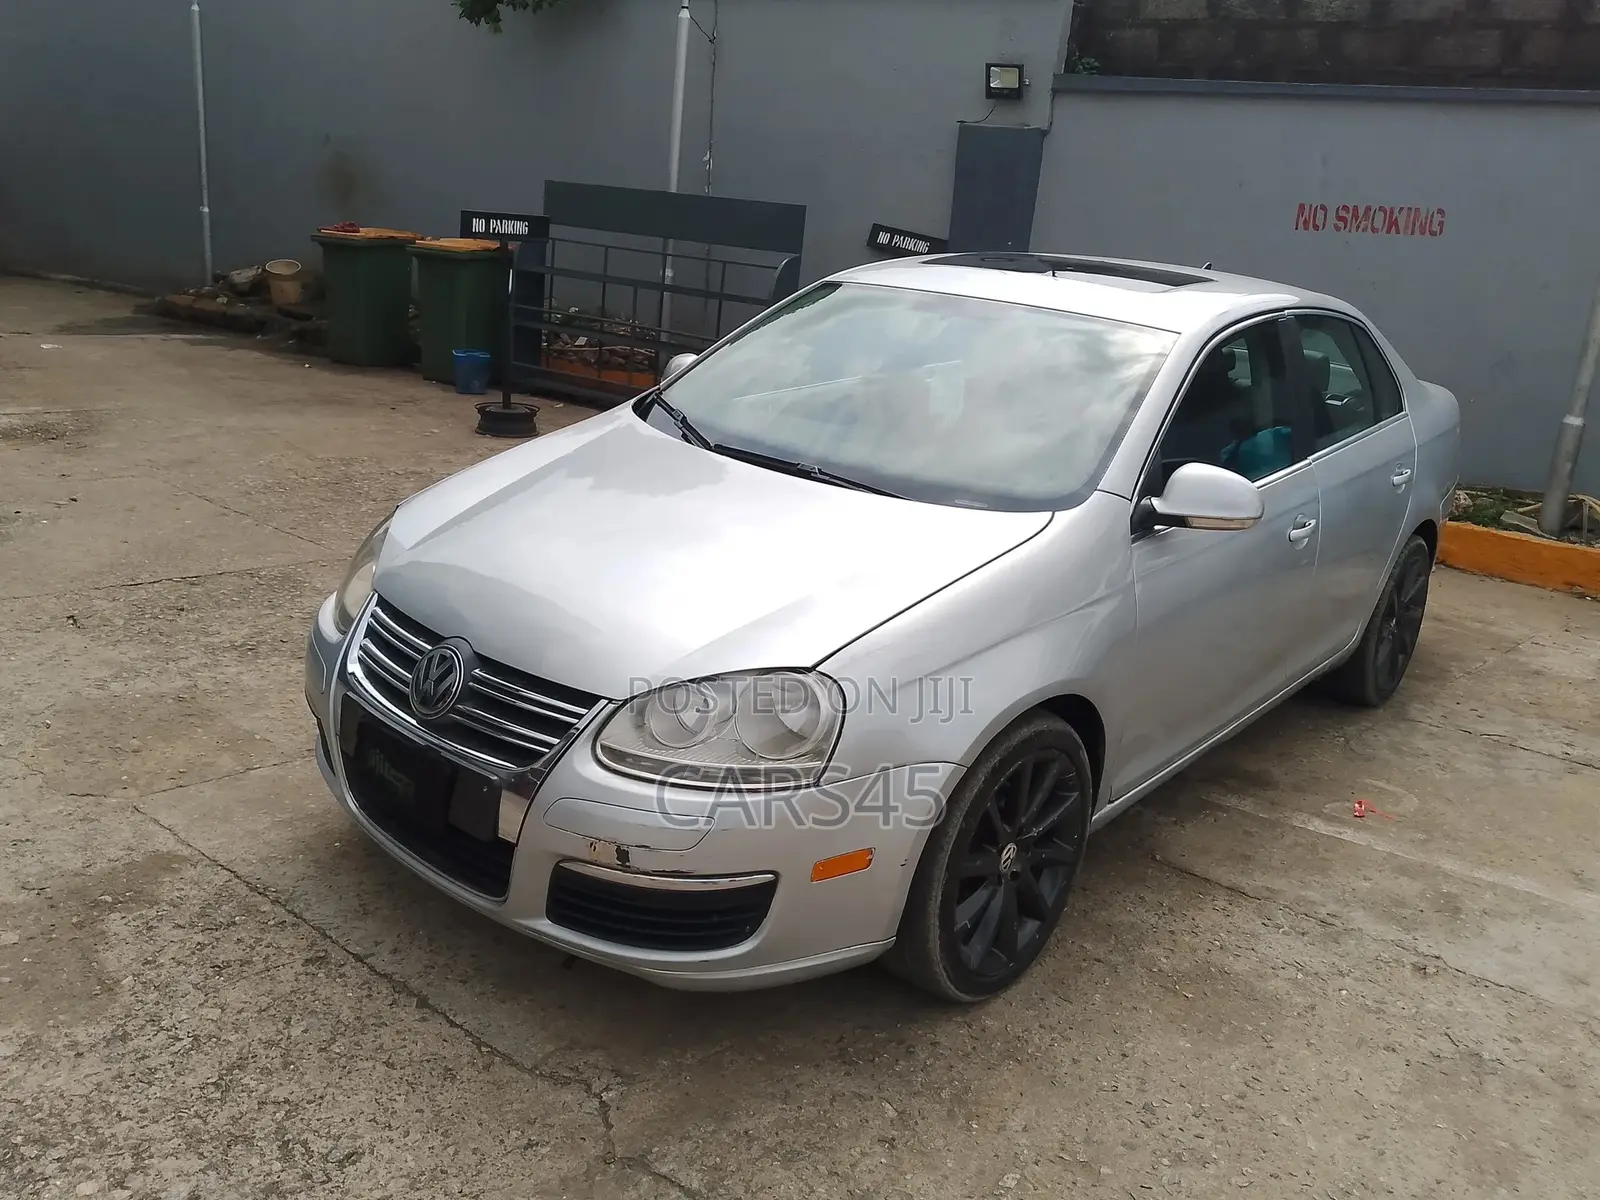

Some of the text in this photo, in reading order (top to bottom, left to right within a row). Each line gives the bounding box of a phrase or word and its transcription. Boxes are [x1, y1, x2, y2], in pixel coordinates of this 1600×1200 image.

[472, 217, 529, 235] NO PARKING
[1294, 202, 1446, 237] NO SMOKING
[876, 231, 930, 253] NO PARKING
